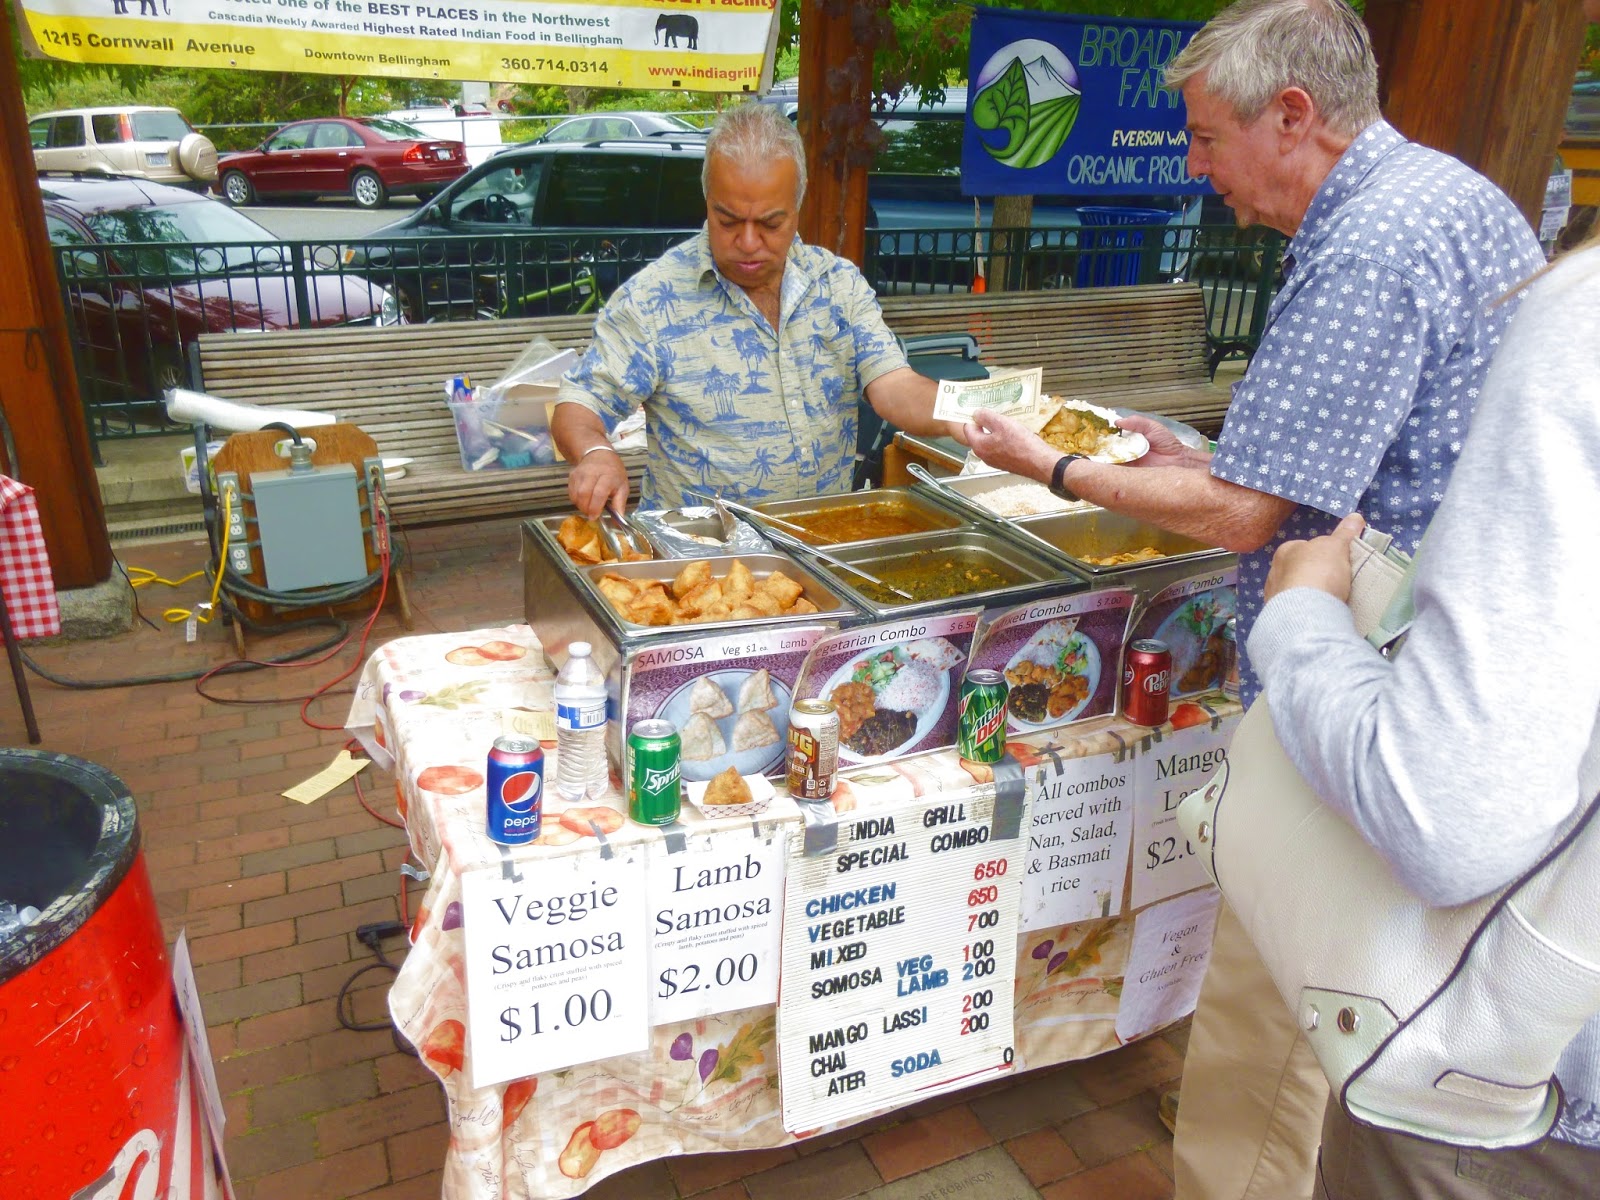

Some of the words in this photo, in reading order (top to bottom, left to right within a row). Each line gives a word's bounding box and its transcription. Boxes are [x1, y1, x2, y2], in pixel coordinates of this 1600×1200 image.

[208, 11, 263, 23] Cascadia
[266, 15, 307, 28] Weekly
[311, 19, 360, 32] Awarded
[363, 22, 416, 35] Highest
[420, 26, 458, 38] Rated
[462, 28, 501, 40] Indian
[505, 30, 536, 40] Food
[540, 32, 551, 42] in
[555, 32, 624, 47] Bellingham
[314, 0, 330, 10] of
[336, 0, 362, 13] the
[368, 2, 410, 17] BEST
[416, 6, 478, 21] PLACES
[483, 10, 498, 22] in
[502, 11, 526, 24] the
[532, 13, 610, 28] Northwest
[42, 29, 82, 48] 1215
[87, 34, 174, 51] Cornwall
[186, 39, 256, 56] Avenue
[304, 48, 374, 62] Downtown
[378, 54, 450, 68] Bellingham
[500, 57, 608, 74] 360.714.0314
[1118, 68, 1180, 108] FAR
[1112, 130, 1165, 147] EVERSON
[1166, 130, 1188, 146] WA
[1067, 154, 1144, 185] ORGANIC
[1189, 576, 1224, 590] Combo
[1001, 610, 1028, 628] ixed
[1030, 603, 1072, 619] Combo
[638, 646, 704, 668] SAMOSA
[722, 646, 740, 656] Veg
[746, 644, 756, 653] $1
[780, 638, 808, 649] Lamb
[815, 634, 876, 657] egetarian
[880, 626, 926, 642] Combo
[1149, 674, 1169, 692] Pepp
[788, 727, 813, 756] UG
[1155, 748, 1226, 781] Mango
[1036, 782, 1062, 802] All
[1066, 774, 1126, 796] combos
[1163, 788, 1198, 812] La
[504, 812, 538, 828] pepsi
[849, 816, 896, 842] INDIA
[924, 804, 966, 828] GRILL
[1032, 804, 1083, 827] served
[1088, 796, 1122, 816] with
[836, 842, 910, 873] SPECIAL
[930, 826, 989, 852] COMBO
[1028, 834, 1065, 852] Nan,
[1070, 820, 1118, 844] Salad,
[672, 854, 762, 893] Lamb
[1027, 858, 1042, 875] &
[1048, 844, 1111, 871] Basmati
[806, 882, 896, 918] CHICKEN
[974, 858, 1008, 880] 650
[1050, 876, 1080, 894] rice
[492, 880, 619, 926] Veggie
[655, 897, 772, 936] Samosa
[808, 906, 905, 943] VEGETABLE
[968, 885, 998, 907] 650
[688, 934, 702, 942] flaky
[751, 922, 768, 930] spiced
[810, 942, 868, 970] MIXED
[968, 910, 999, 932] 700
[1162, 924, 1198, 943] Vegan
[492, 930, 626, 976] Samosa
[1171, 944, 1182, 956] &
[520, 976, 531, 985] and
[588, 962, 602, 971] with
[658, 953, 758, 1000] $2.00
[812, 967, 882, 999] SOMOSA
[896, 954, 934, 978] VEG
[962, 940, 994, 962] 100
[896, 968, 949, 997] LAMB
[962, 958, 996, 981] 200
[1140, 962, 1178, 984] Gluten
[1180, 950, 1208, 968] Free
[532, 980, 557, 991] potatoes
[558, 977, 570, 985] and
[500, 988, 612, 1044] $1.00
[809, 1022, 868, 1054] MANGO
[884, 1006, 928, 1034] LASSI
[962, 990, 993, 1012] 200
[810, 1051, 847, 1078] CHAI
[960, 1012, 990, 1036] 200
[828, 1070, 866, 1097] ATER
[890, 1048, 942, 1078] SODA
[1003, 1046, 1014, 1065] 0
[940, 1170, 995, 1197] ROBINSON
